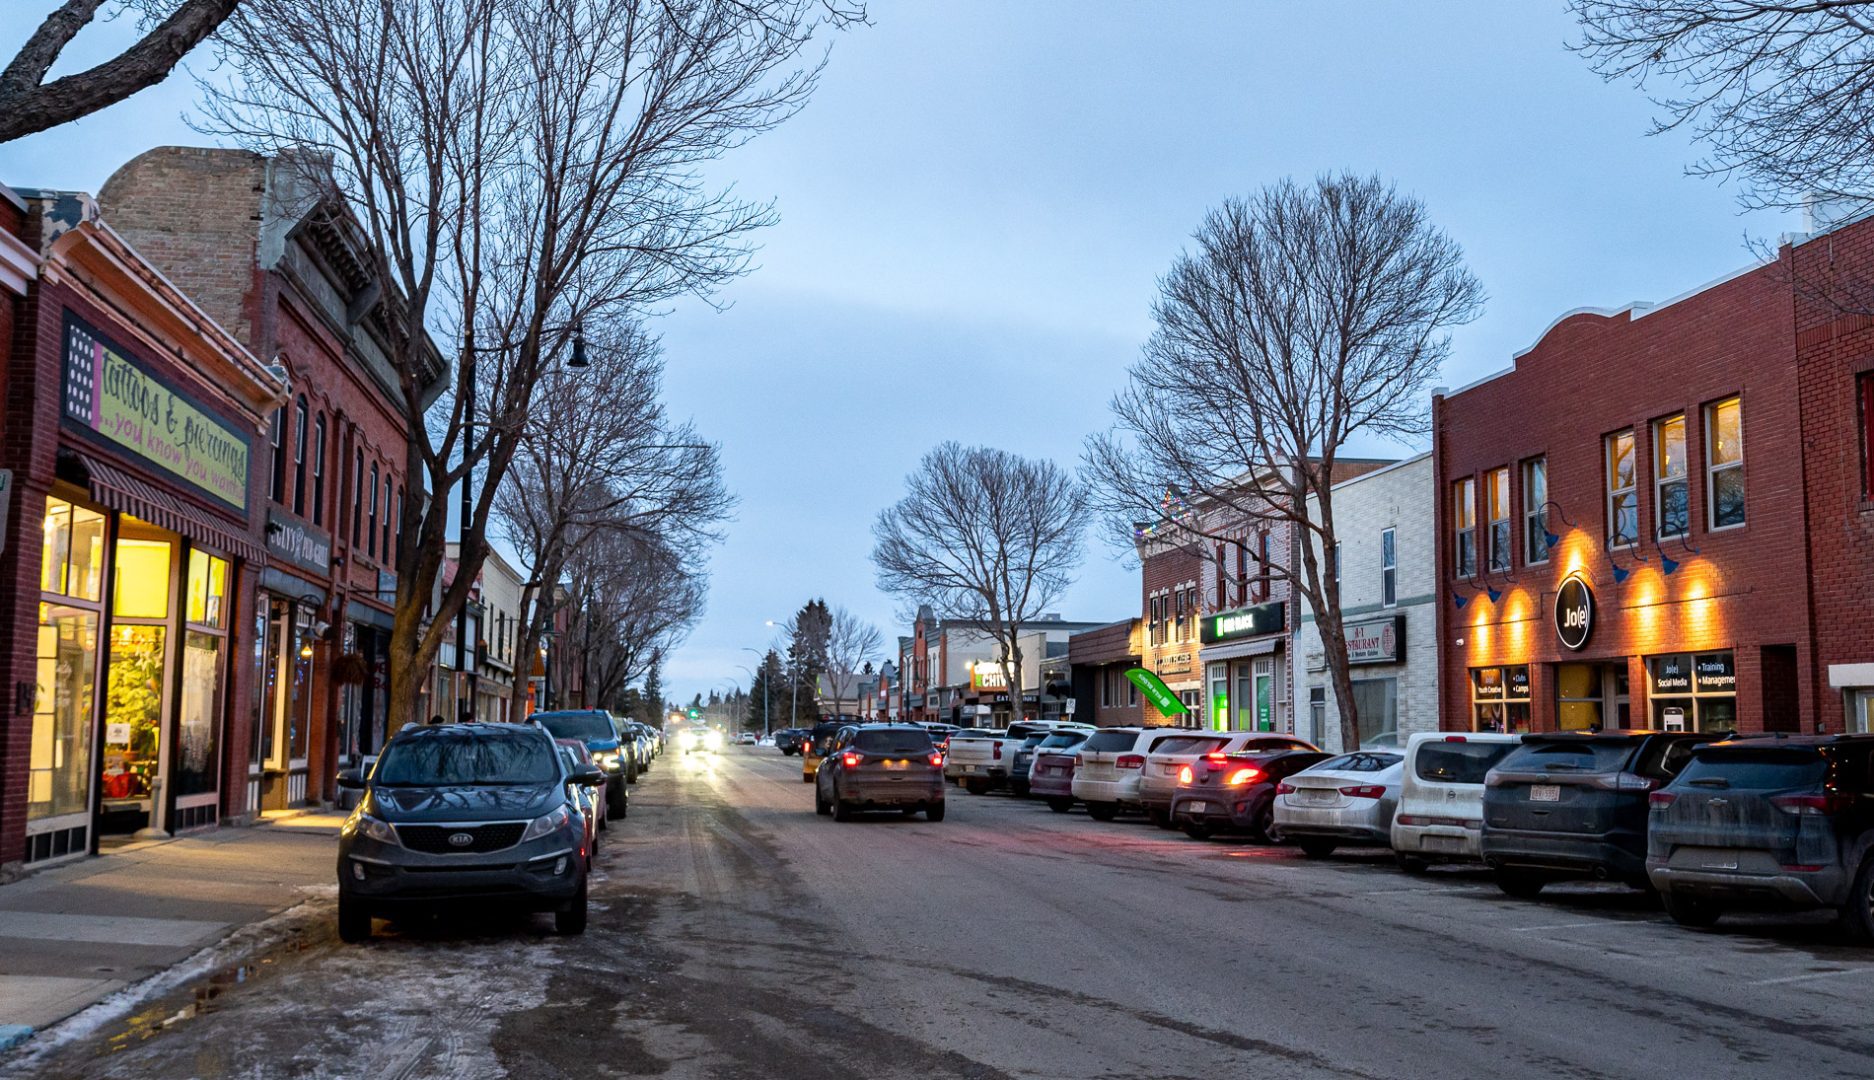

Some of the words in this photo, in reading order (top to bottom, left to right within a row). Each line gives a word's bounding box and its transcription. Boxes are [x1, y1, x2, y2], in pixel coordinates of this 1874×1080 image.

[102, 351, 159, 426] tattoos
[166, 393, 178, 434] &
[174, 416, 246, 487] piercings
[147, 428, 182, 465] know
[185, 457, 208, 482] you
[1564, 605, 1588, 629] Jo(e)
[1666, 665, 1679, 674] Jo(e)
[1702, 662, 1725, 674] Training
[982, 674, 1007, 687] CHIV
[1657, 678, 1672, 688] Social
[1672, 677, 1688, 687] Media
